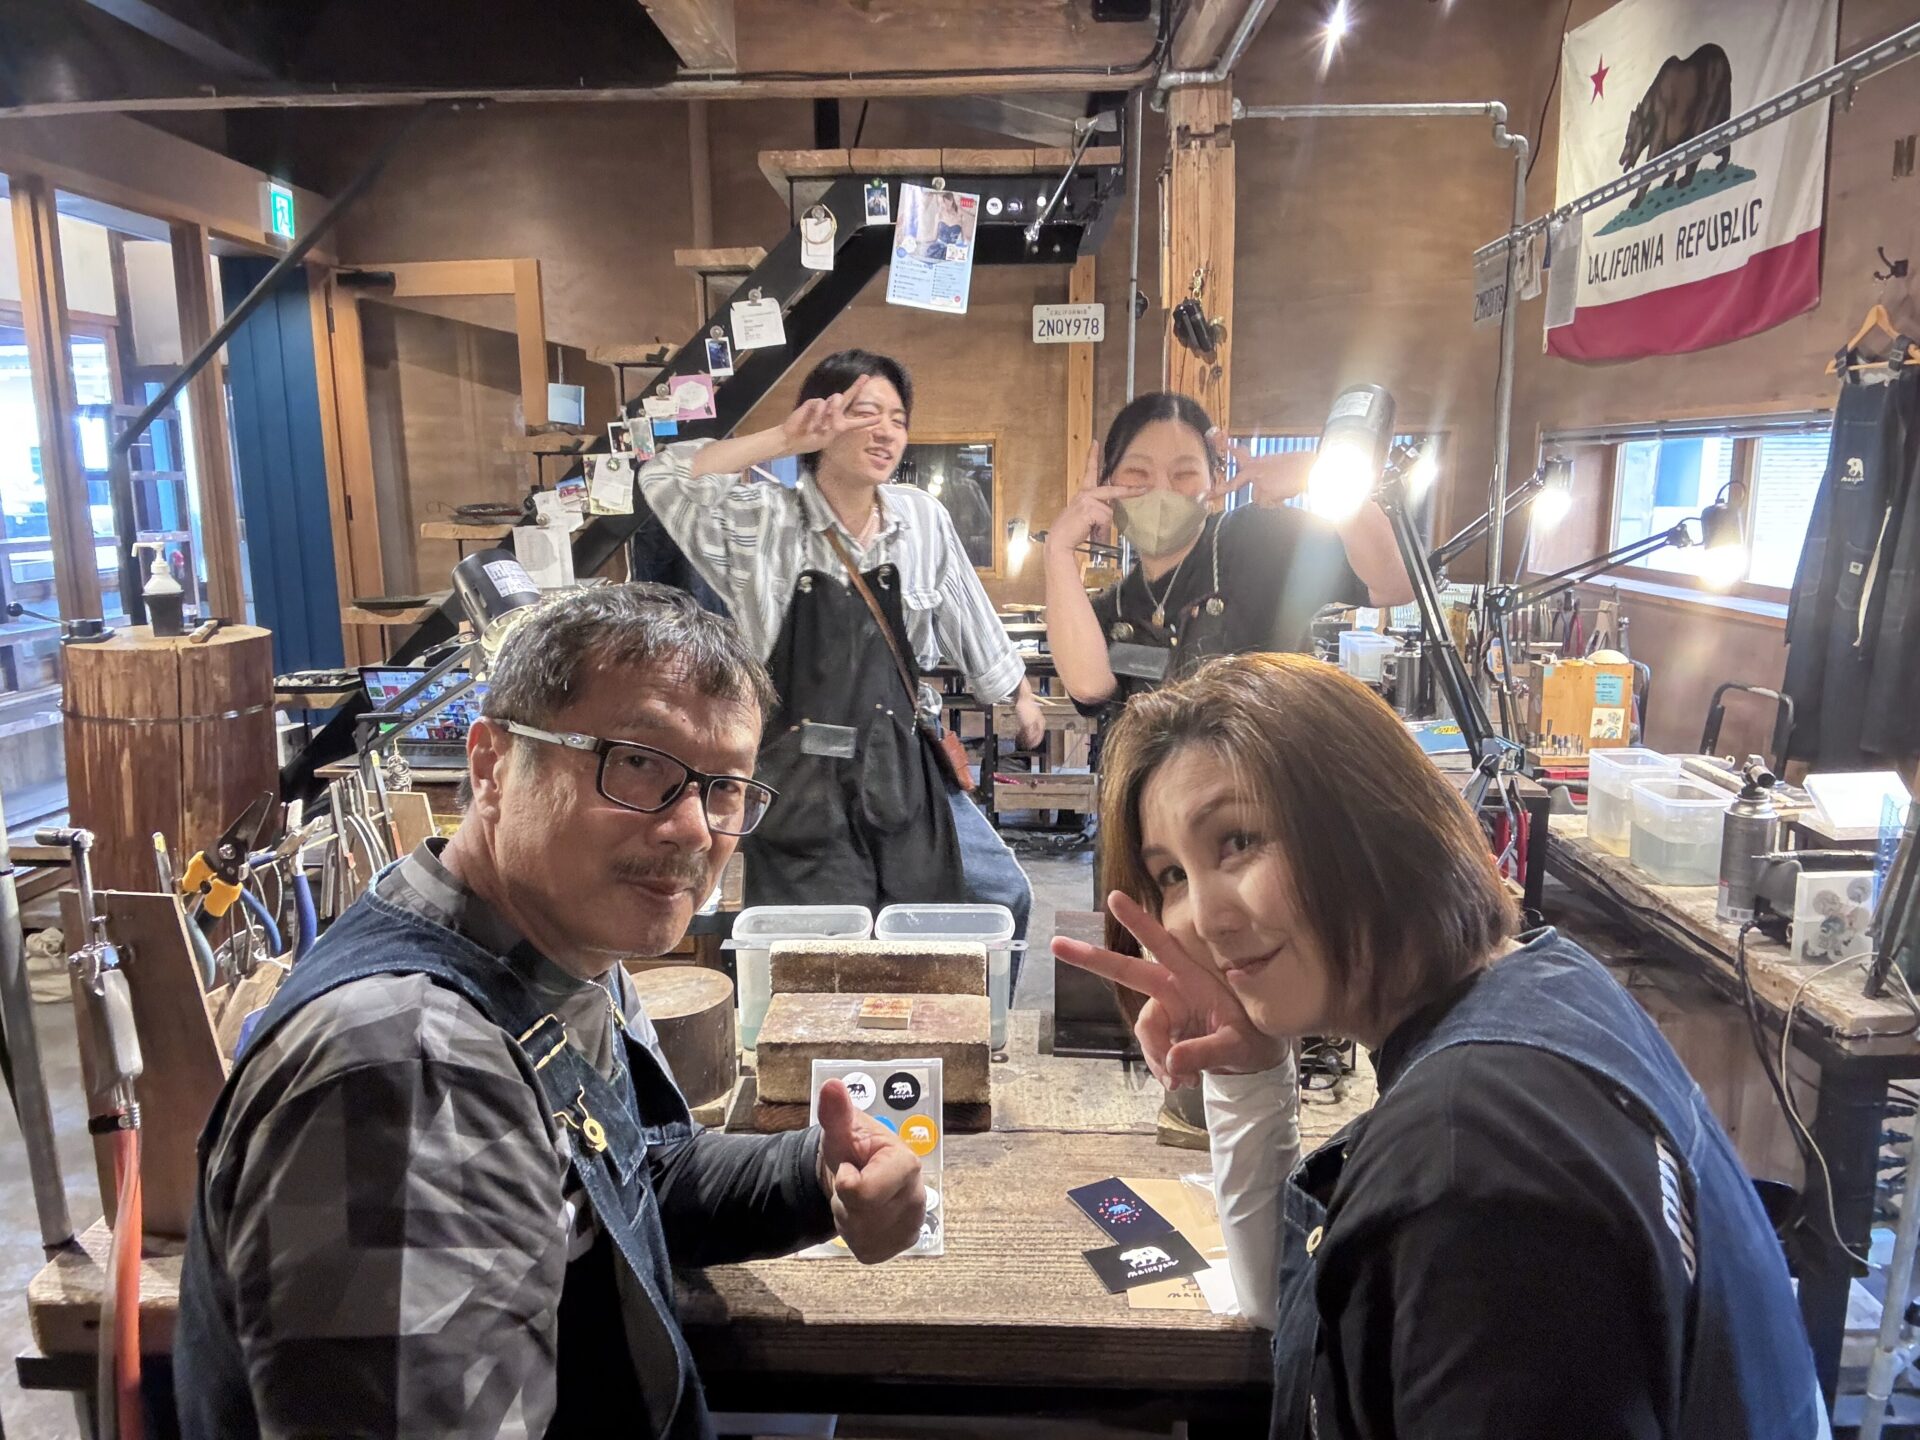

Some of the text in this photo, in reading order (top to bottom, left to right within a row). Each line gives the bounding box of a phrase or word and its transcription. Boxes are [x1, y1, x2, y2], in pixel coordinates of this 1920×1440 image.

[1588, 198, 1762, 285] CALIFORNIA REPUBLIC
[1038, 317, 1099, 337] 2NQY978
